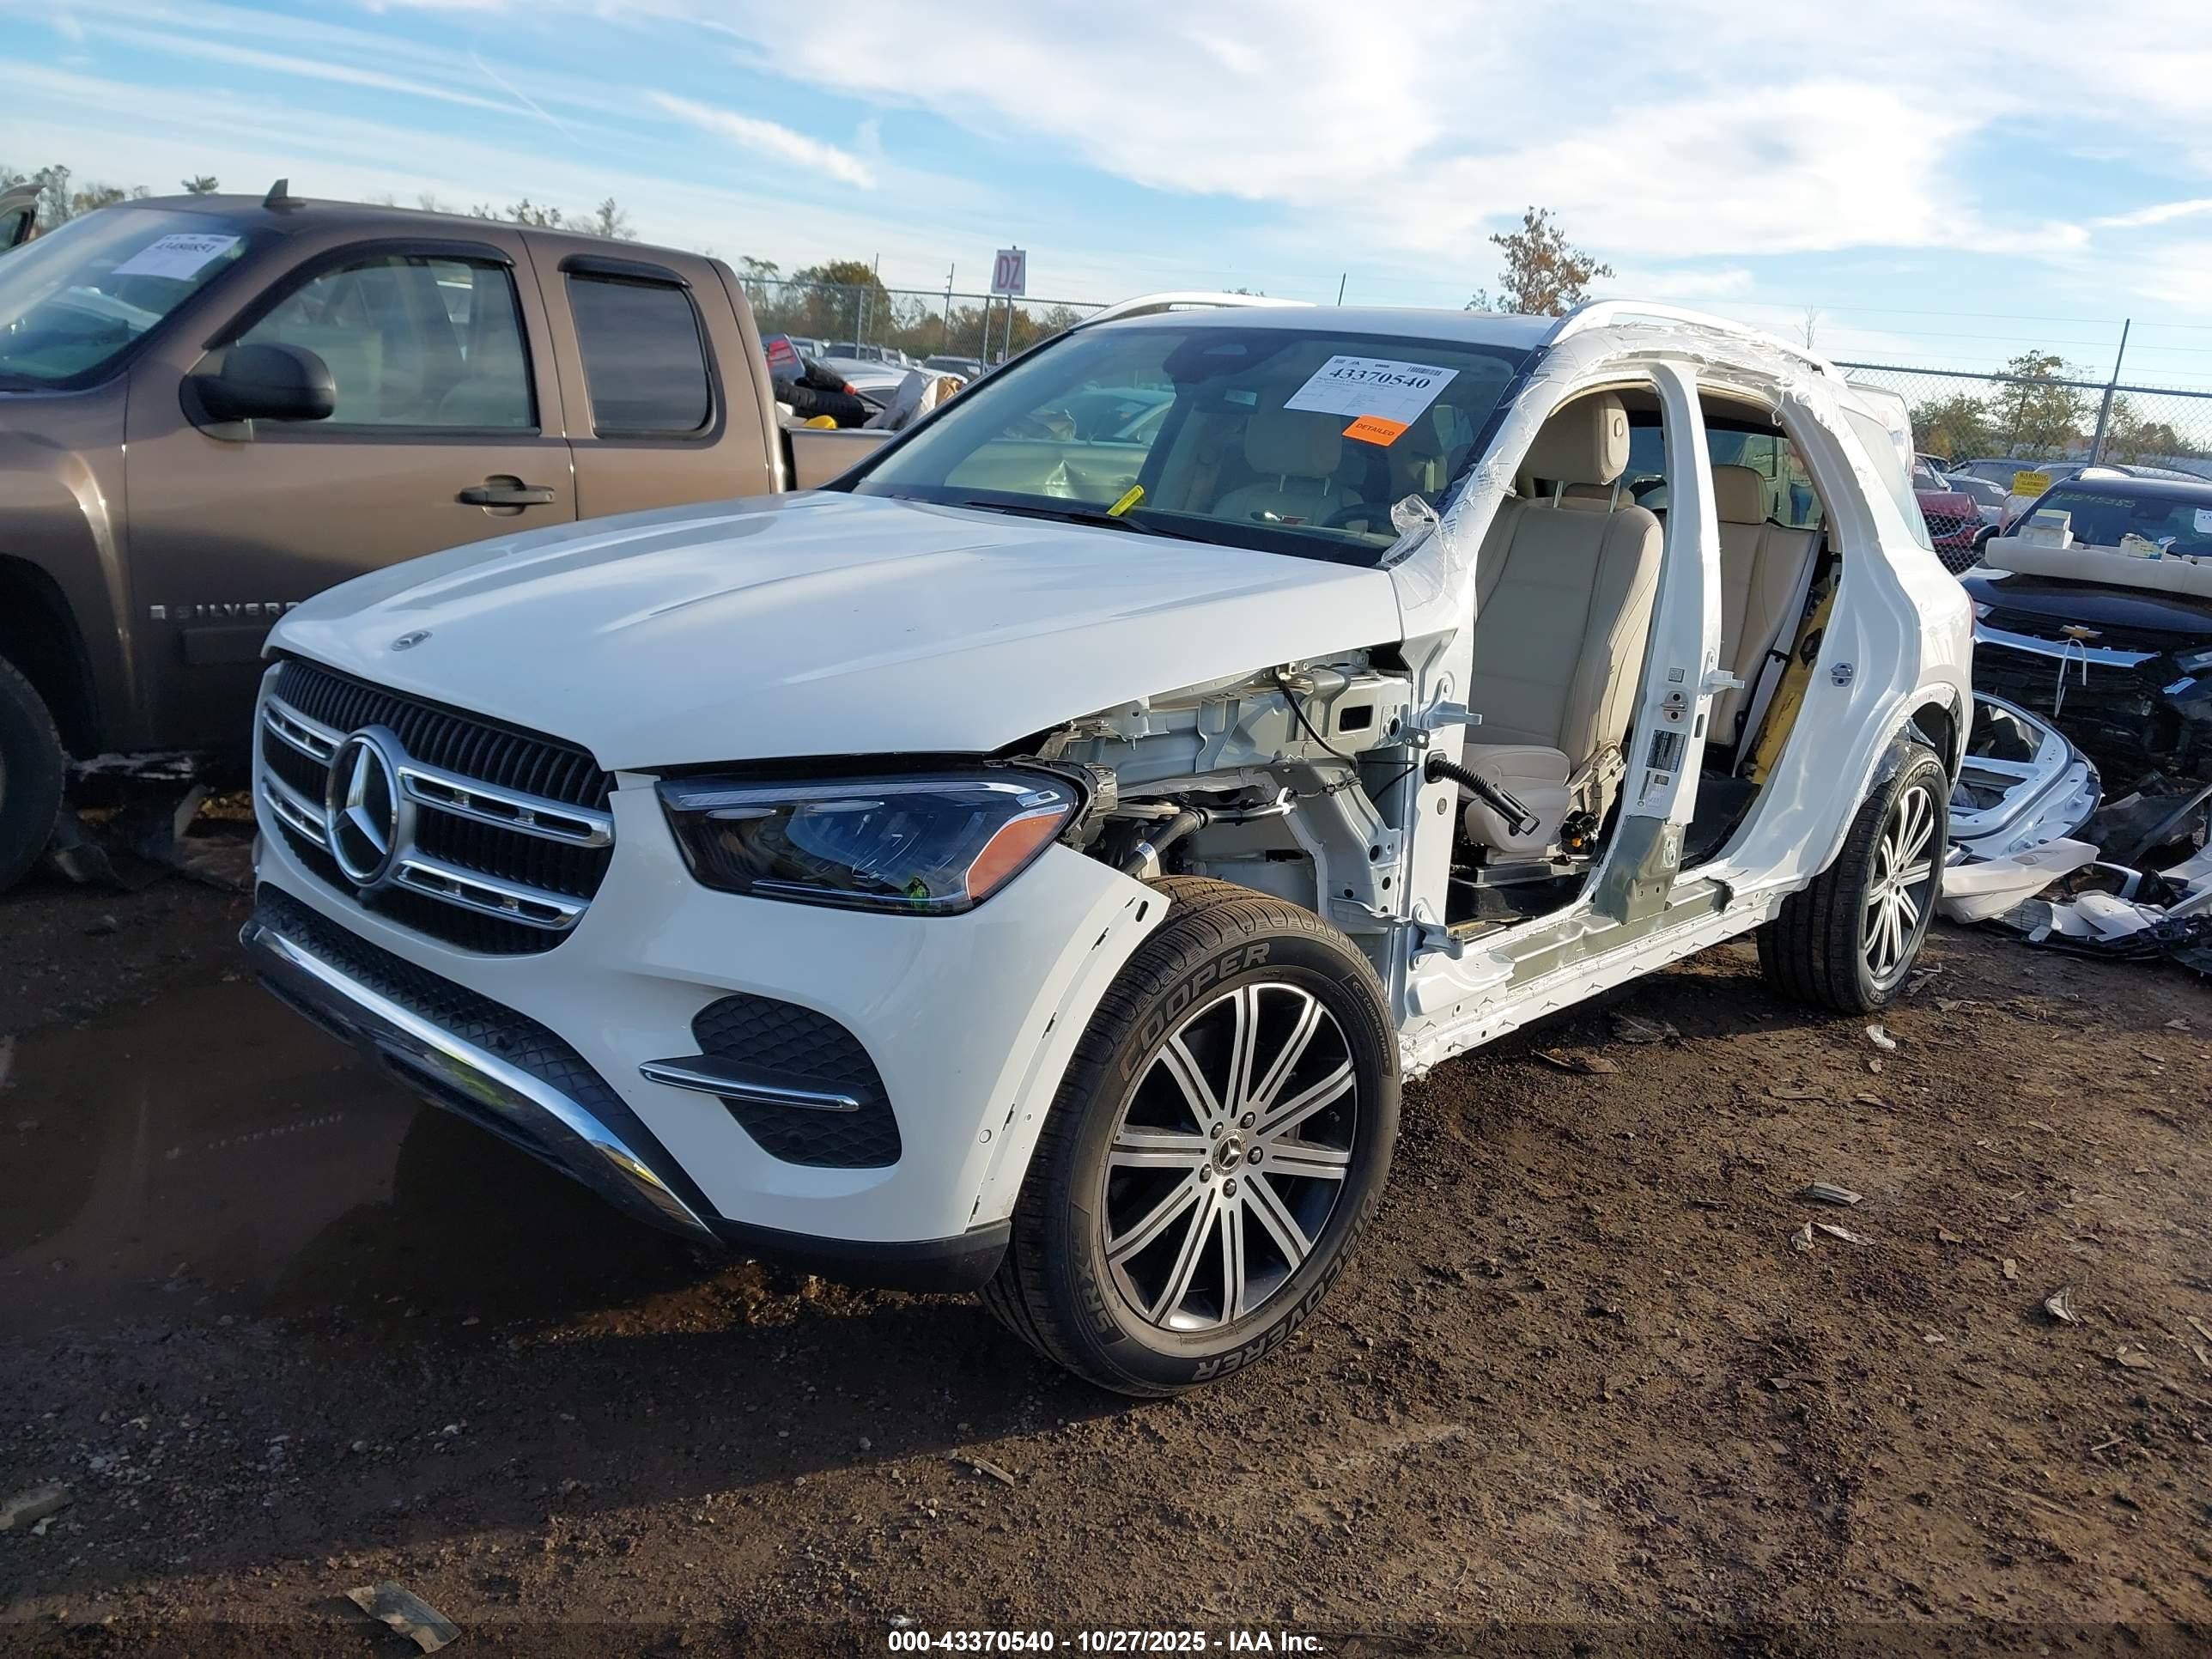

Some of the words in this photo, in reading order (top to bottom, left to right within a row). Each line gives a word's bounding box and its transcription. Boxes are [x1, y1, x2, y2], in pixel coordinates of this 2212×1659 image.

[997, 256, 1021, 290] DZ
[1329, 368, 1431, 389] 43370540
[1355, 422, 1395, 436] DETAILED
[1120, 943, 1270, 1081] COOPER
[1192, 1188, 1376, 1382] DISCOVERER
